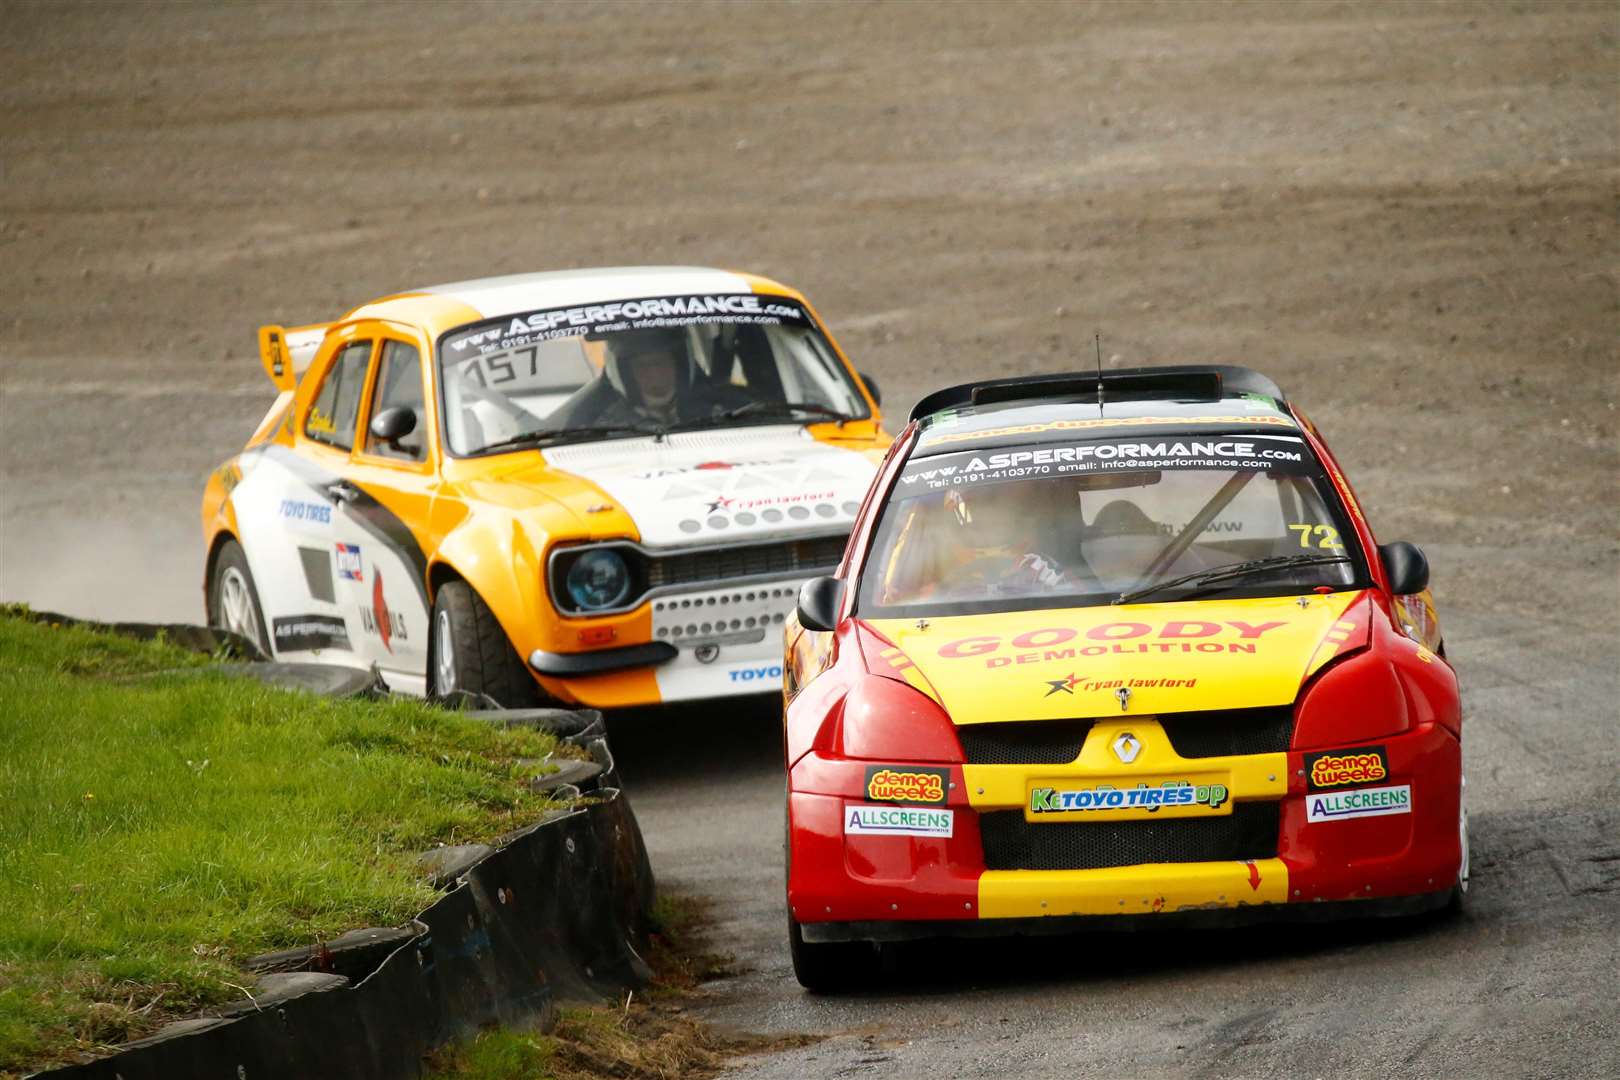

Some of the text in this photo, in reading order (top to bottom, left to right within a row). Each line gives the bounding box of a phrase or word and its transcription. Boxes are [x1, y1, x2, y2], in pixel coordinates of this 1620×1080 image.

[464, 346, 538, 389] 157
[927, 458, 1272, 489] Tel: 0191-4103770 email: info@asperformance.com
[1287, 523, 1345, 550] 72
[937, 620, 1290, 658] GOODY
[985, 641, 1258, 669] DEMOLITION
[728, 666, 782, 681] TOYO
[1084, 677, 1199, 693] ryan lawford
[1313, 753, 1382, 774] demon
[871, 769, 942, 788] demon
[1311, 766, 1386, 787] tweeks
[868, 783, 944, 802] tweeks
[1062, 790, 1124, 808] TOYO
[1127, 787, 1194, 806] TIRES
[1312, 789, 1408, 817] ALLSCREENS
[849, 810, 950, 829] ALLSCREENS
